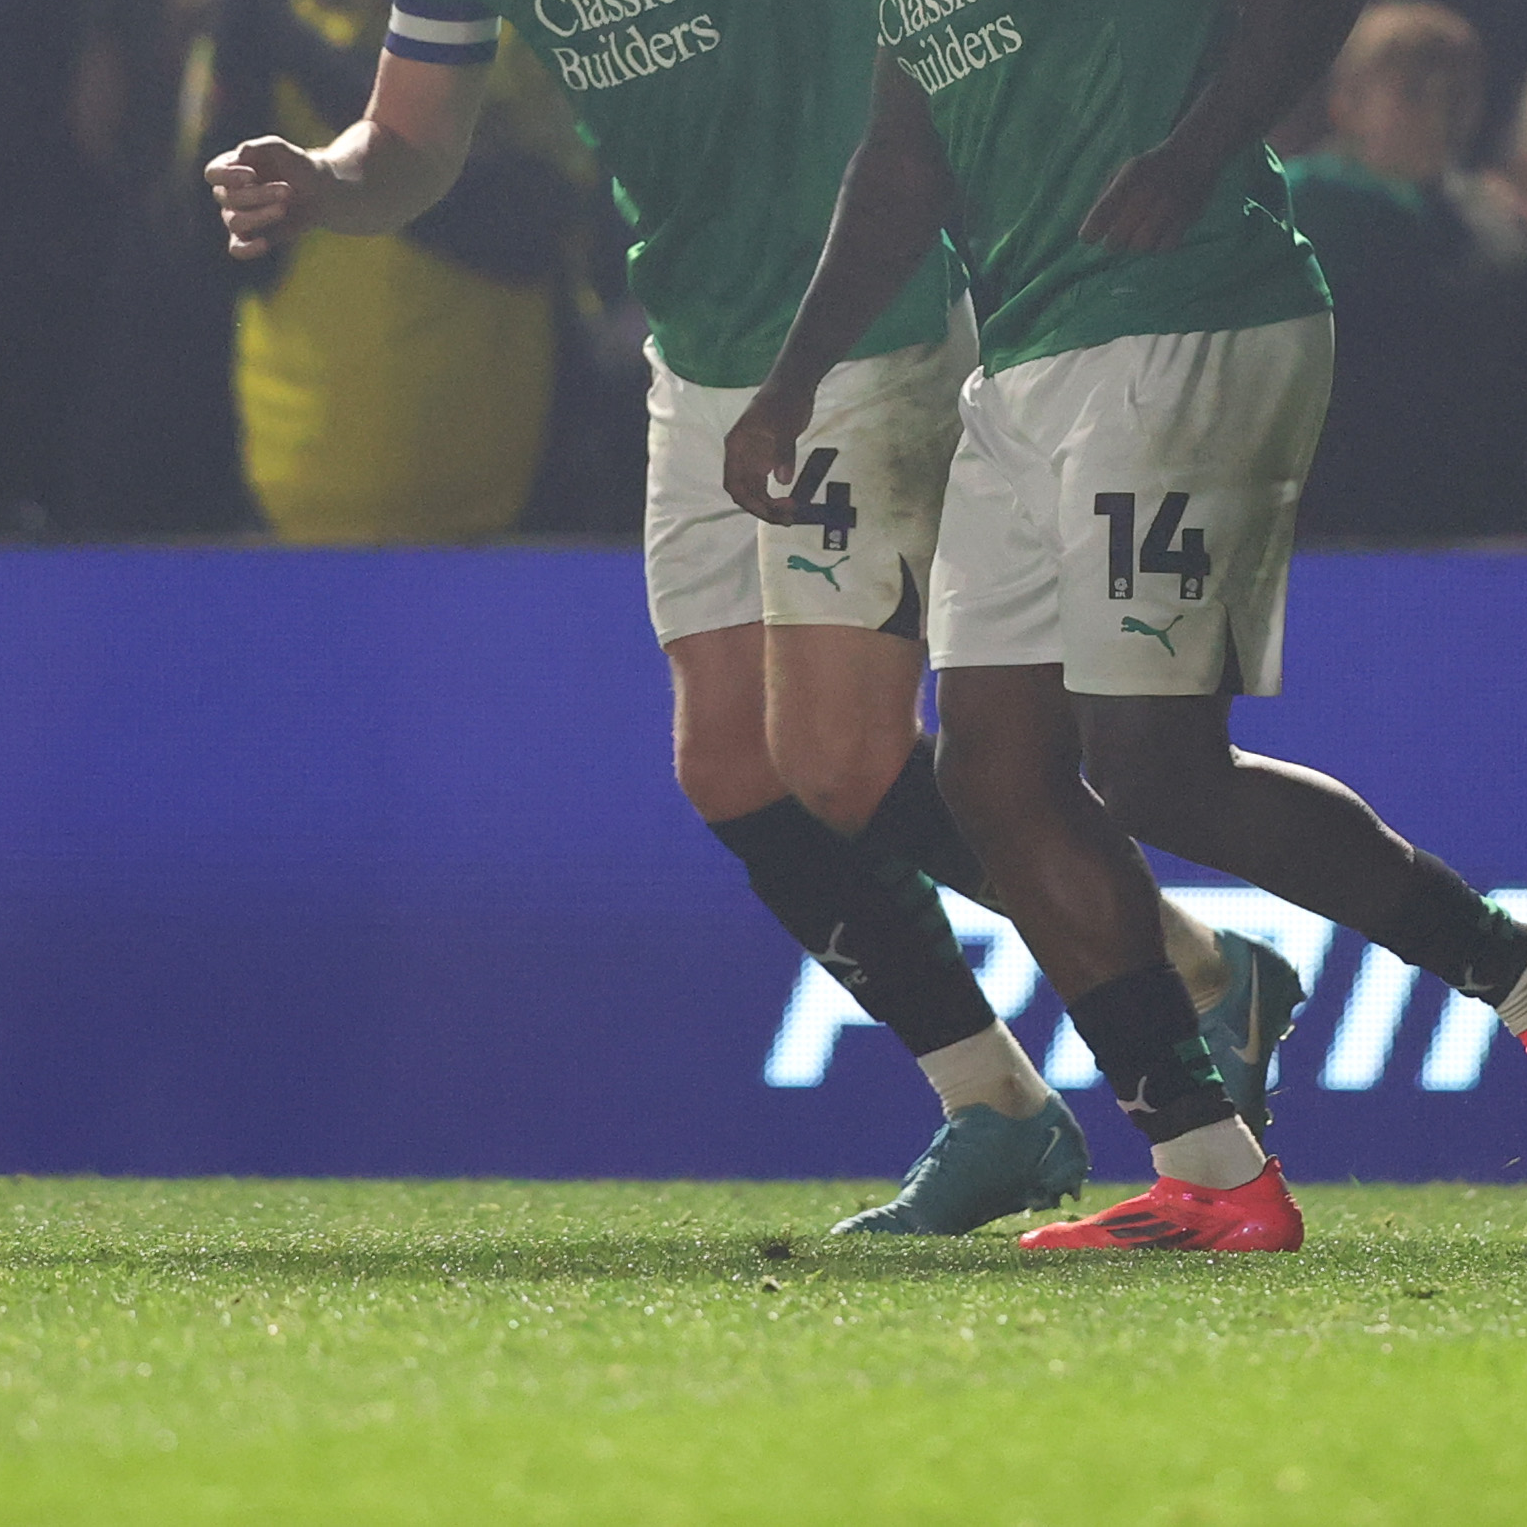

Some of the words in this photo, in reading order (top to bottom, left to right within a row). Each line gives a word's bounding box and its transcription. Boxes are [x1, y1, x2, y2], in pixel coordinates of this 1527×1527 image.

[551, 14, 722, 92] Builders
[789, 446, 858, 551] 4
[1094, 491, 1212, 600] 14
